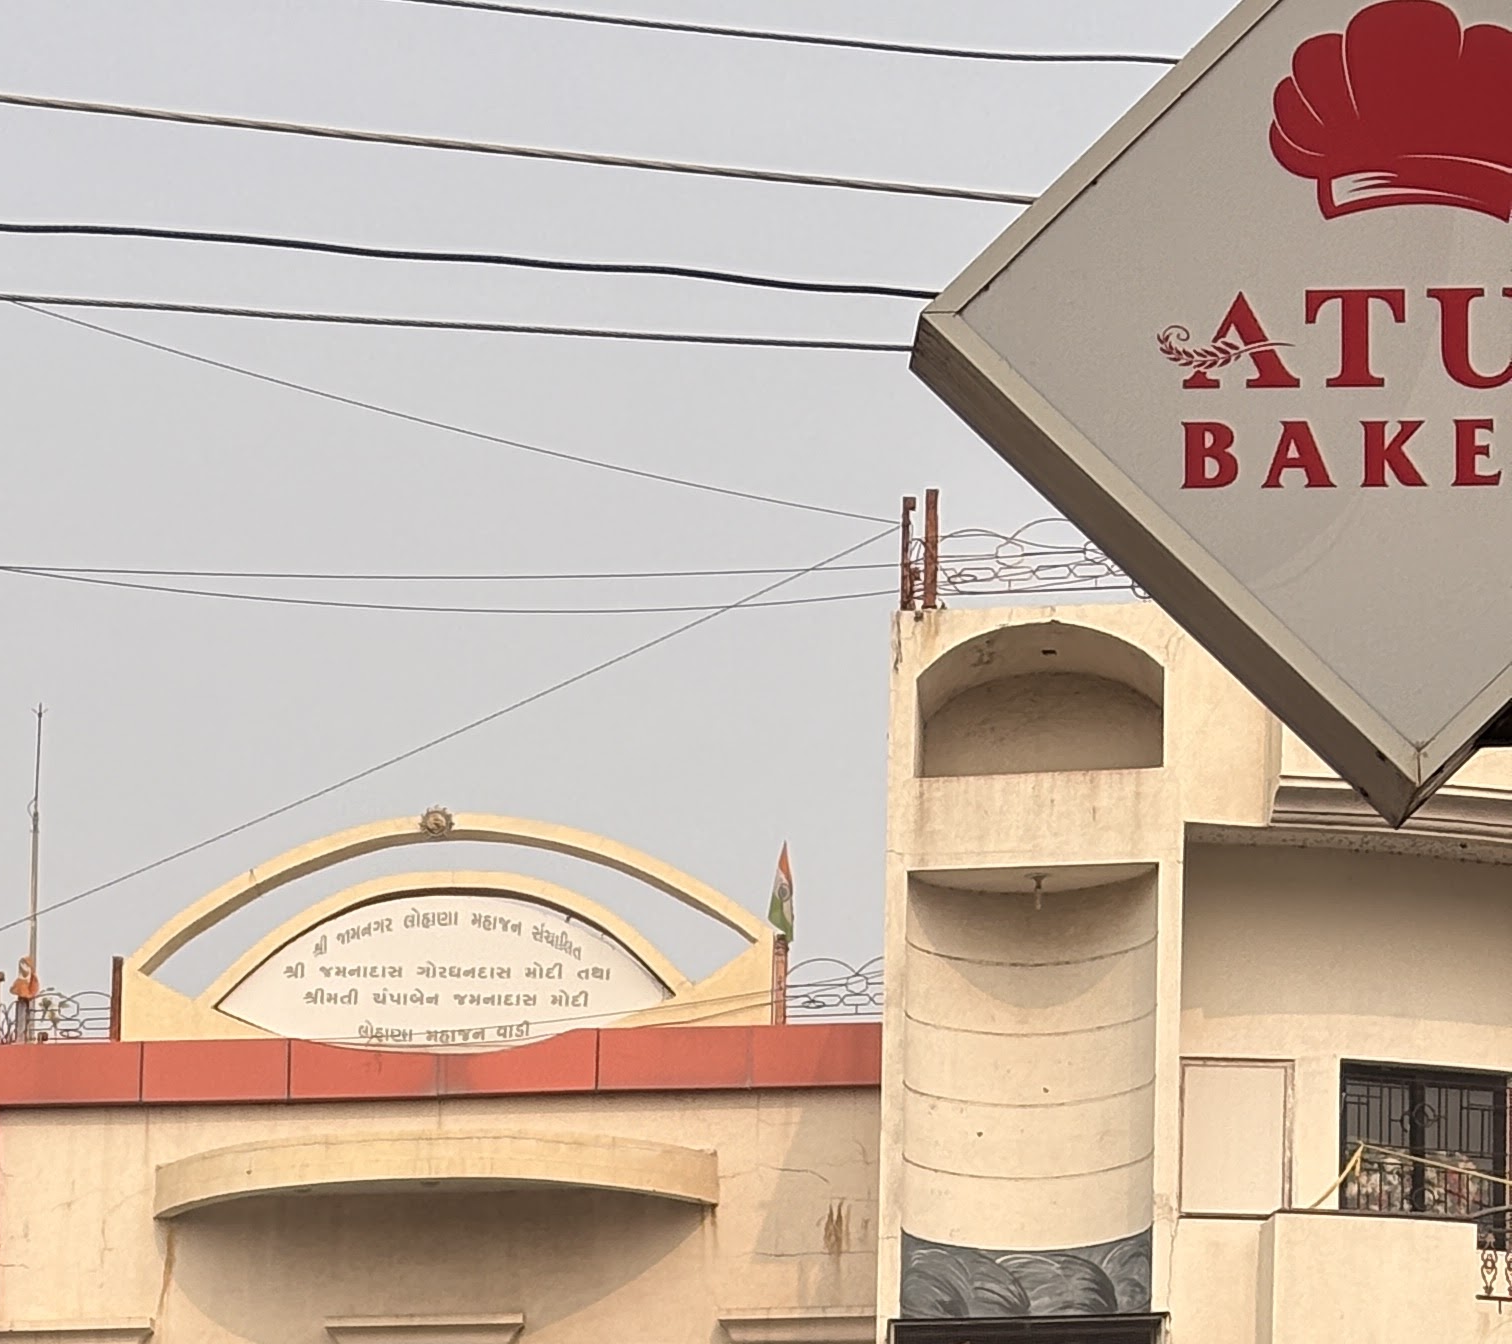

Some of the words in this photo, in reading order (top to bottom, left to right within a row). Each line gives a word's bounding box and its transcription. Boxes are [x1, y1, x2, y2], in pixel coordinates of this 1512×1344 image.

[1181, 418, 1502, 490] BAKE
[471, 911, 522, 936] મહાજન
[283, 961, 305, 979] શ્રી
[319, 965, 403, 978] જમનાદાસ
[524, 961, 563, 979] મોદી
[577, 967, 611, 980] તથા
[303, 988, 358, 1005] શ્રીમતી
[372, 987, 439, 1006] ચંપાબેન
[453, 993, 537, 1007] જમનાદાસ
[550, 989, 589, 1008] મોદી
[426, 1029, 485, 1043] મહાજન
